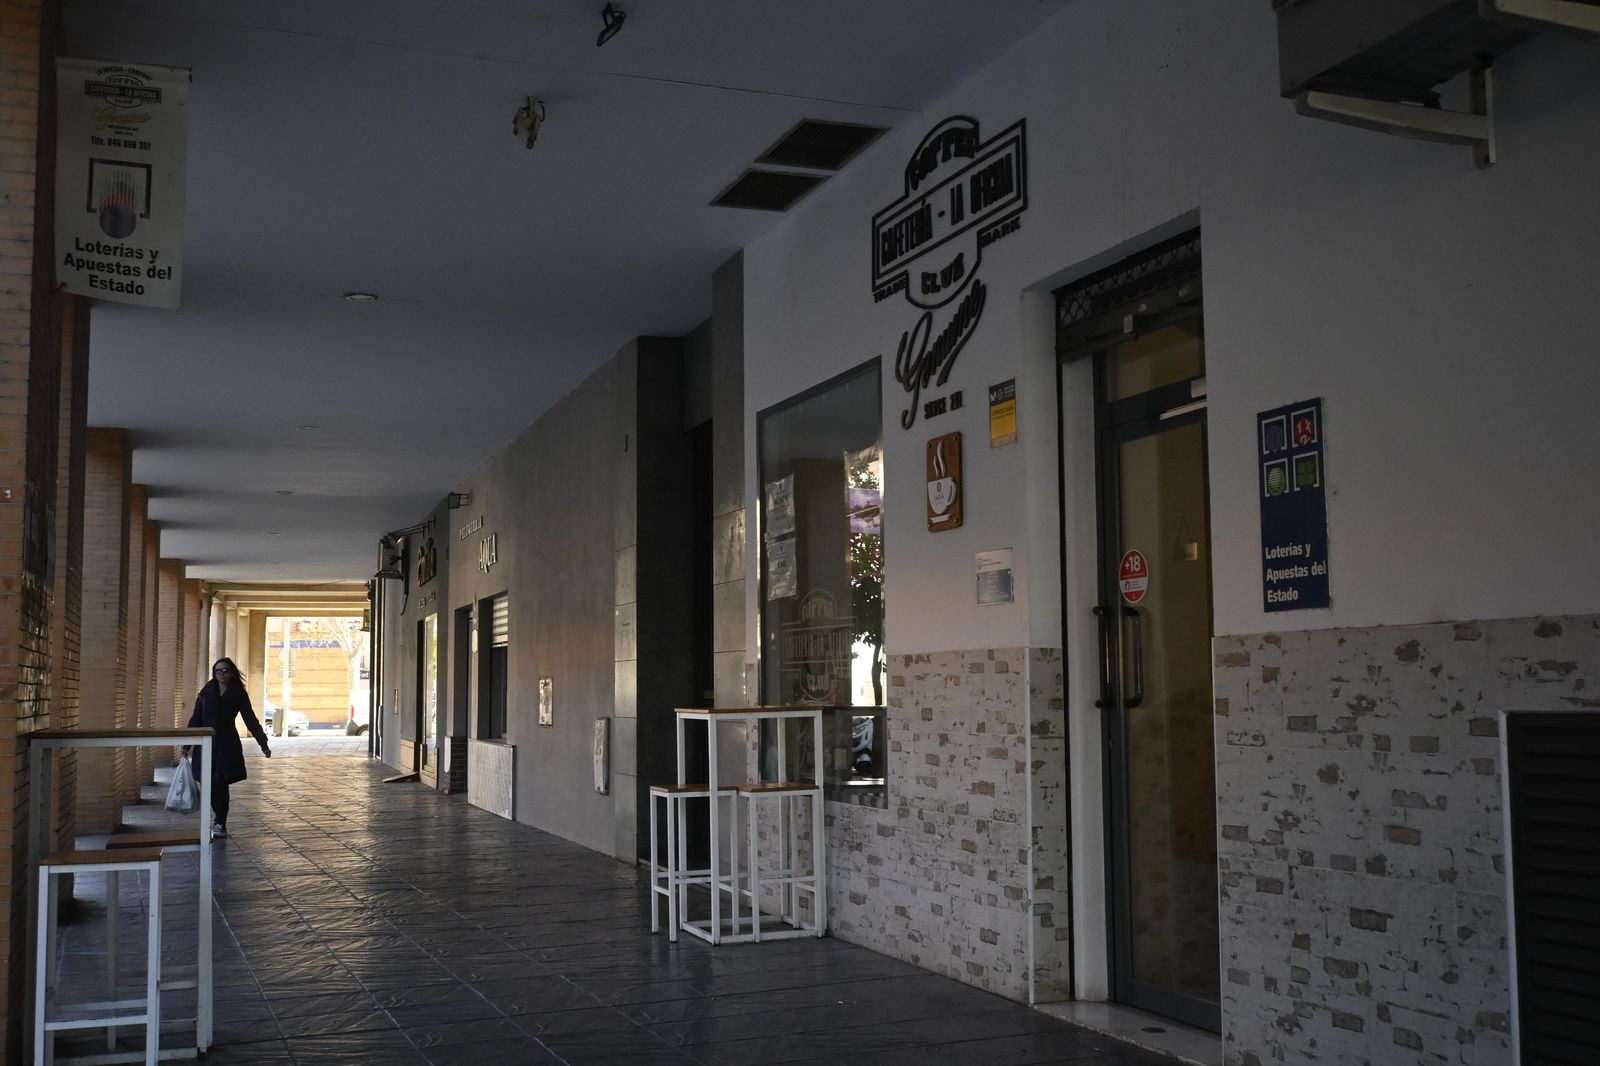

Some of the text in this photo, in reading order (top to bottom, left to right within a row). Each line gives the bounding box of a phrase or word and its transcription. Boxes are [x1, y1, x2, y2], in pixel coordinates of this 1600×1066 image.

[910, 127, 976, 190] COFFEE
[881, 199, 933, 267] CAFETERÍA
[950, 183, 963, 225] LA
[979, 216, 1021, 248] MARK
[75, 237, 159, 264] Loterías y
[64, 253, 172, 280] Apuestas del
[921, 252, 964, 294] CLUB
[88, 274, 145, 295] Estado
[873, 277, 908, 303] TRADE
[1124, 555, 1141, 572] +18
[1265, 542, 1311, 560] Loterías y
[1266, 560, 1327, 584] Apuestas del
[1267, 586, 1299, 603] Estado
